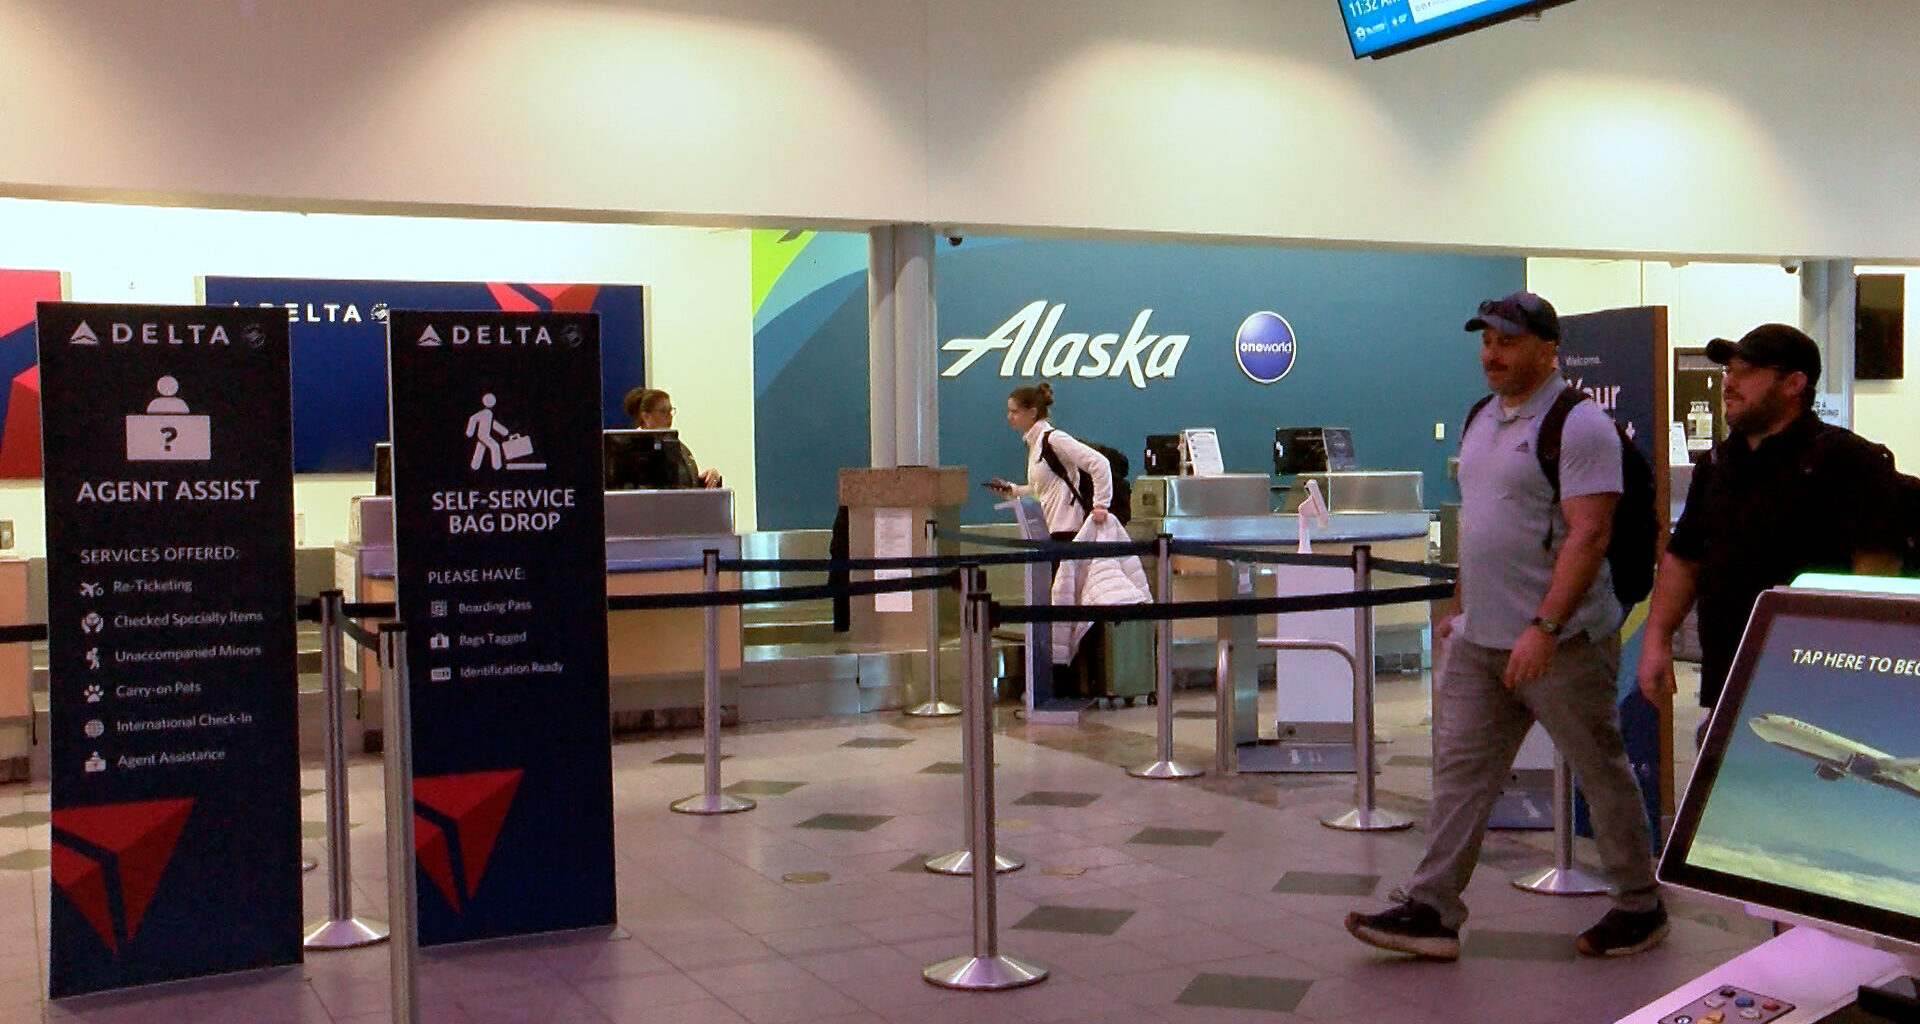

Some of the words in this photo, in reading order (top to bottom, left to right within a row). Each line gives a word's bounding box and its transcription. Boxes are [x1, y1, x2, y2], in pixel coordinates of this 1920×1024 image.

[1349, 0, 1378, 17] 11:32
[259, 302, 362, 323] ELTA
[112, 324, 229, 344] DELTA
[453, 326, 552, 344] DELTA
[941, 300, 1190, 388] Alaska
[1240, 341, 1292, 353] oneworld
[160, 427, 177, 451] ?
[77, 481, 168, 502] AGENT
[176, 480, 260, 500] ASSIST
[432, 489, 576, 510] SELF-SERVICE
[450, 513, 495, 534] BAG
[501, 512, 560, 532] DROP
[81, 548, 160, 563] SERVICES
[165, 546, 238, 560] OFFERED:
[428, 569, 478, 584] PLEASE
[113, 579, 193, 593] Re-Ticketing
[459, 602, 506, 614] Boarding
[508, 600, 532, 610] Pass
[114, 613, 169, 627] Checked
[172, 612, 227, 627] Specialty
[230, 611, 263, 622] Items
[459, 635, 485, 647] Bags
[488, 632, 526, 645] Tagged
[115, 647, 216, 662] Unaccompanied
[219, 645, 261, 656] Minors
[1794, 649, 1823, 664] TAP
[1824, 652, 1866, 670] HERE
[1869, 657, 1891, 672] TO
[461, 663, 530, 678] Identification
[532, 661, 564, 674] Ready
[116, 684, 172, 699] Carry-on
[175, 682, 201, 694] Pets
[117, 717, 196, 731] International
[199, 712, 252, 726] Check-In
[118, 754, 156, 769] Agent
[160, 751, 225, 764] Assistance
